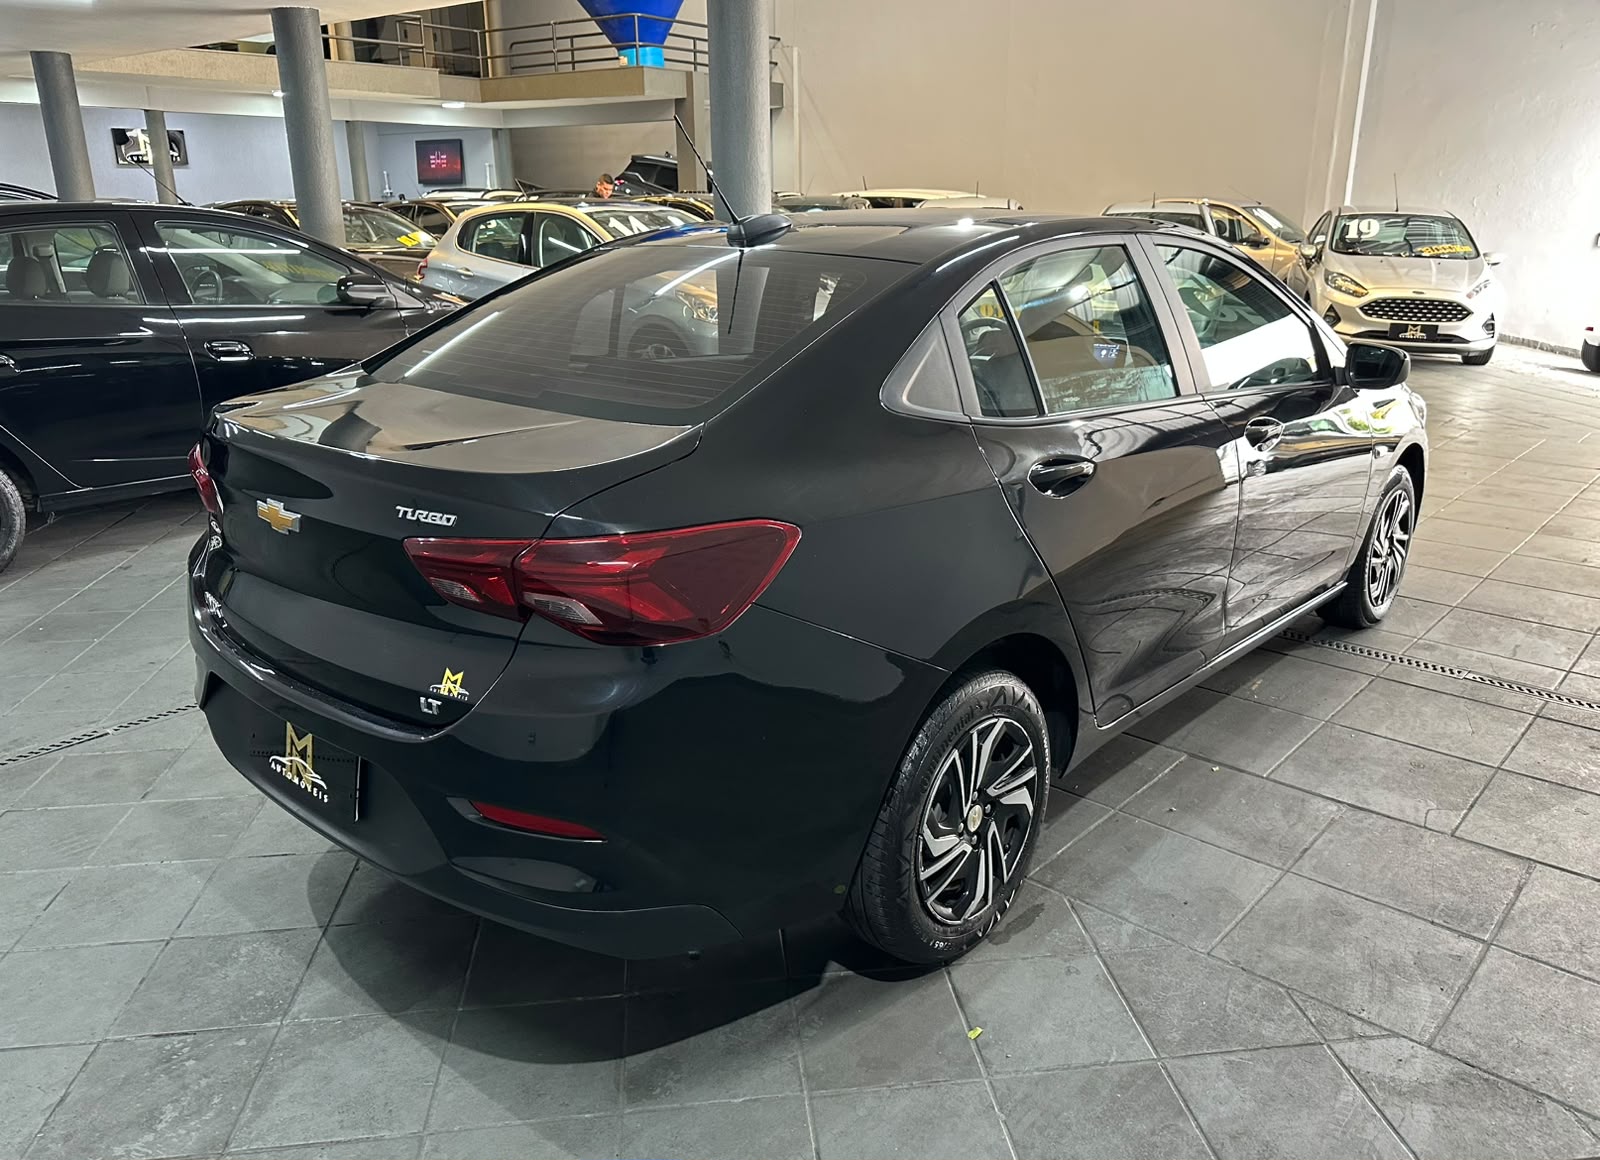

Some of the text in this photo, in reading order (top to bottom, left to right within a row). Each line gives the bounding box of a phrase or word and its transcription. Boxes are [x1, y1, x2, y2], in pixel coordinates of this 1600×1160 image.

[1344, 218, 1380, 239] 19
[395, 505, 458, 527] TURBO
[419, 696, 443, 716] LT
